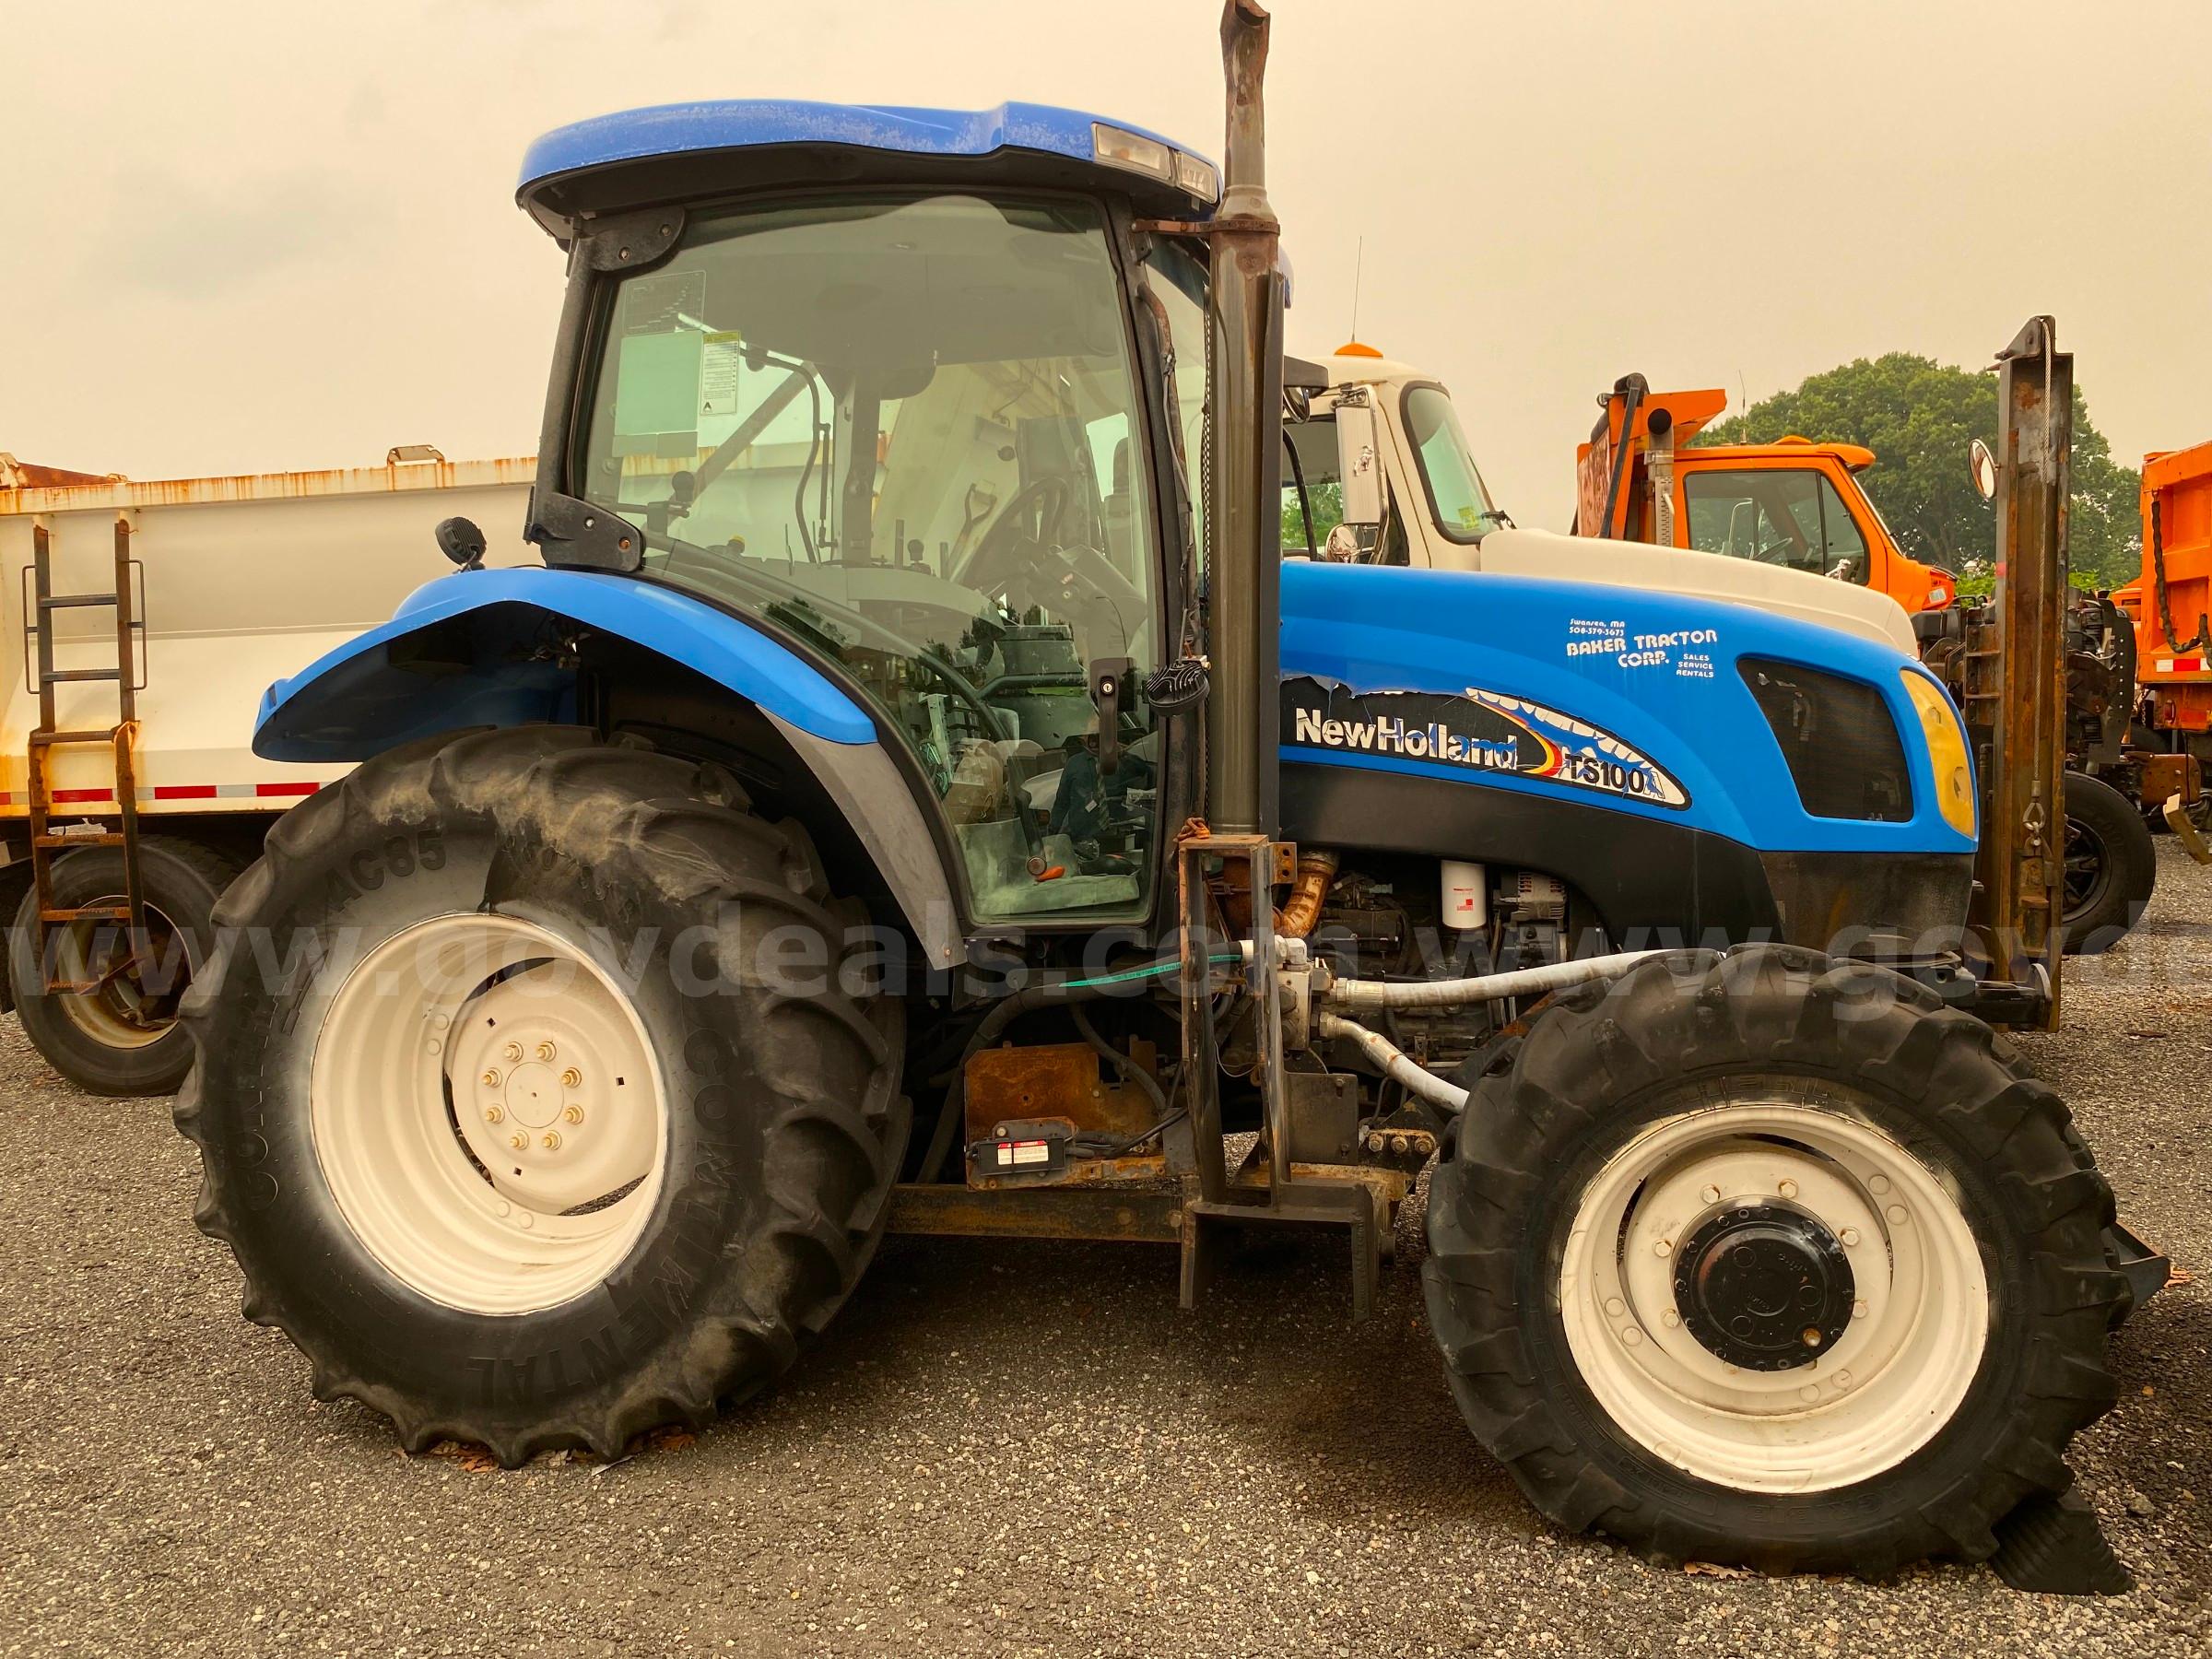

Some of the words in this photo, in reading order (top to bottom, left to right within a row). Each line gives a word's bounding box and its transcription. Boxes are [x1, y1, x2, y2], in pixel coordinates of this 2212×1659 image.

[1570, 618, 1606, 629] Swansea,
[1566, 638, 1627, 657] BAKER
[1633, 629, 1718, 650] TRACTOR
[1618, 650, 1670, 668] CORP.
[1683, 653, 1710, 662] SALES
[1677, 661, 1714, 670] SERVICE
[1676, 669, 1714, 678] RENTALS
